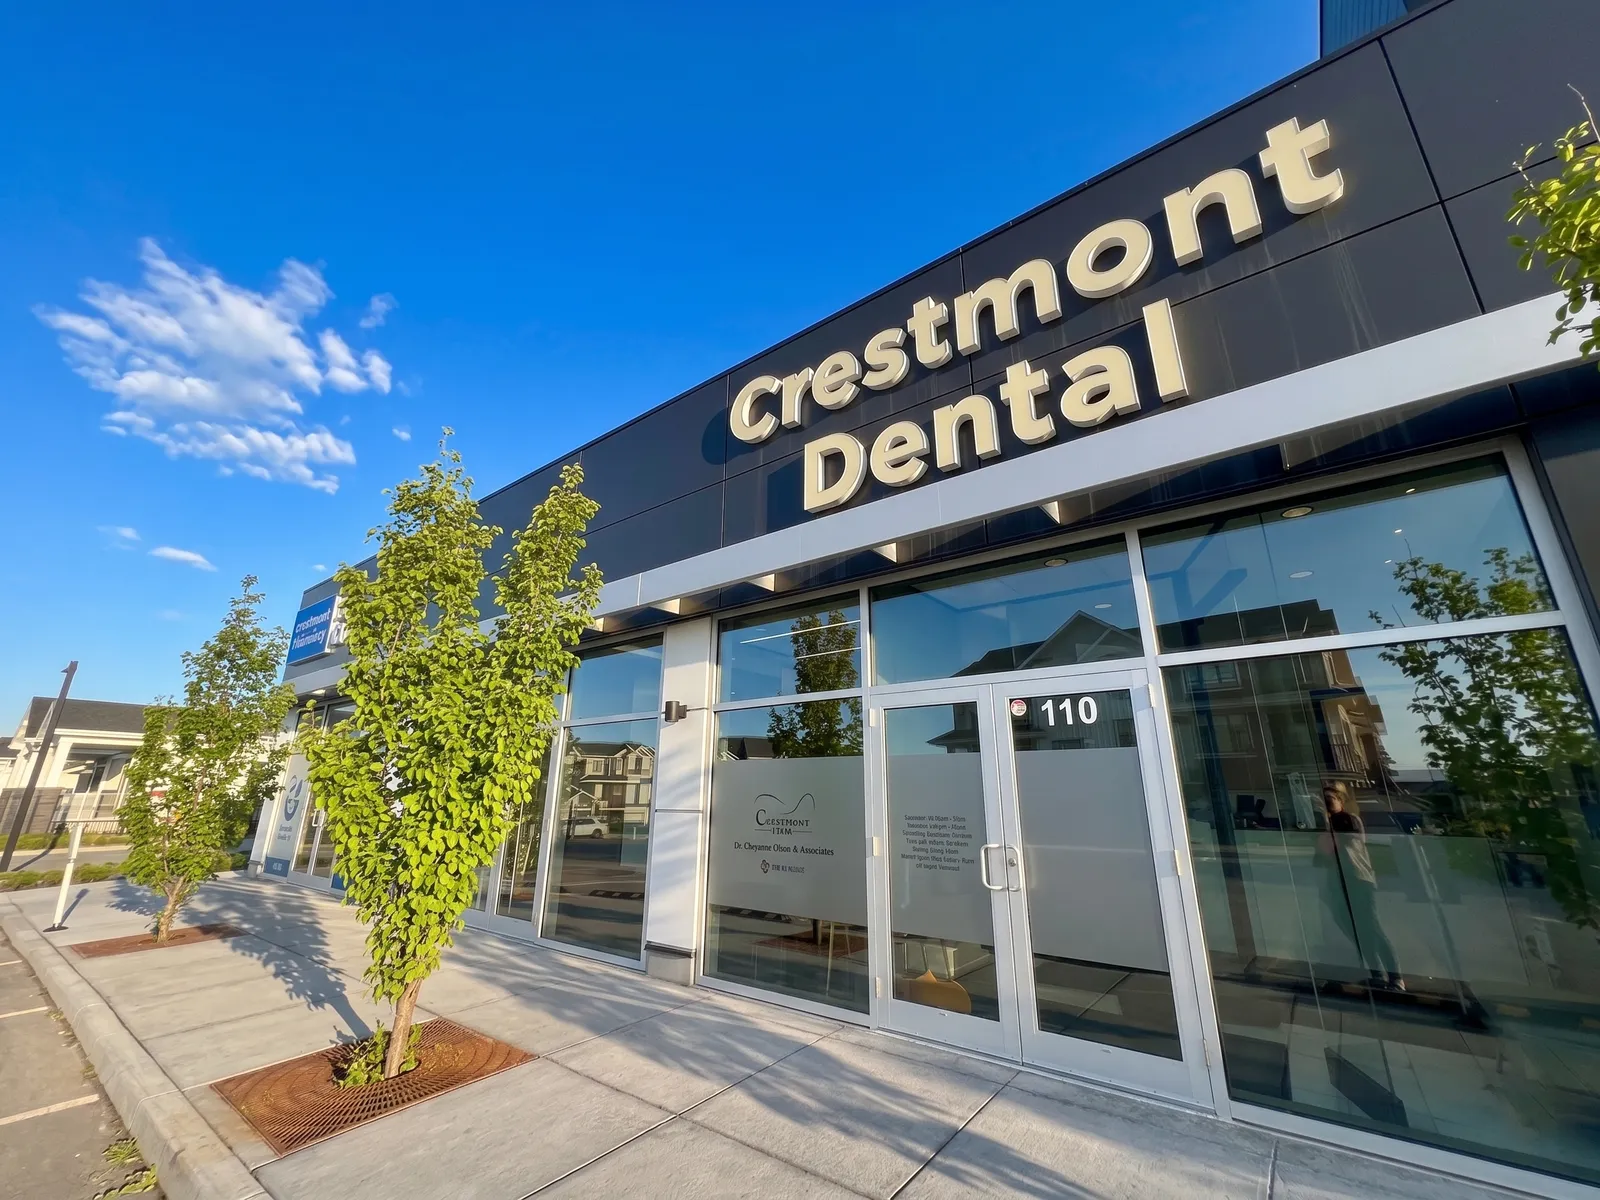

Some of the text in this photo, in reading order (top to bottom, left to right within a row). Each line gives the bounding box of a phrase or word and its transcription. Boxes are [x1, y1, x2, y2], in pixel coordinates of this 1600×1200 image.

[729, 117, 1343, 444] Crestmont
[804, 298, 1189, 513] Dental
[1041, 696, 1097, 726] 110
[734, 842, 834, 856] Dr. Cheyanne Olson & Associates
